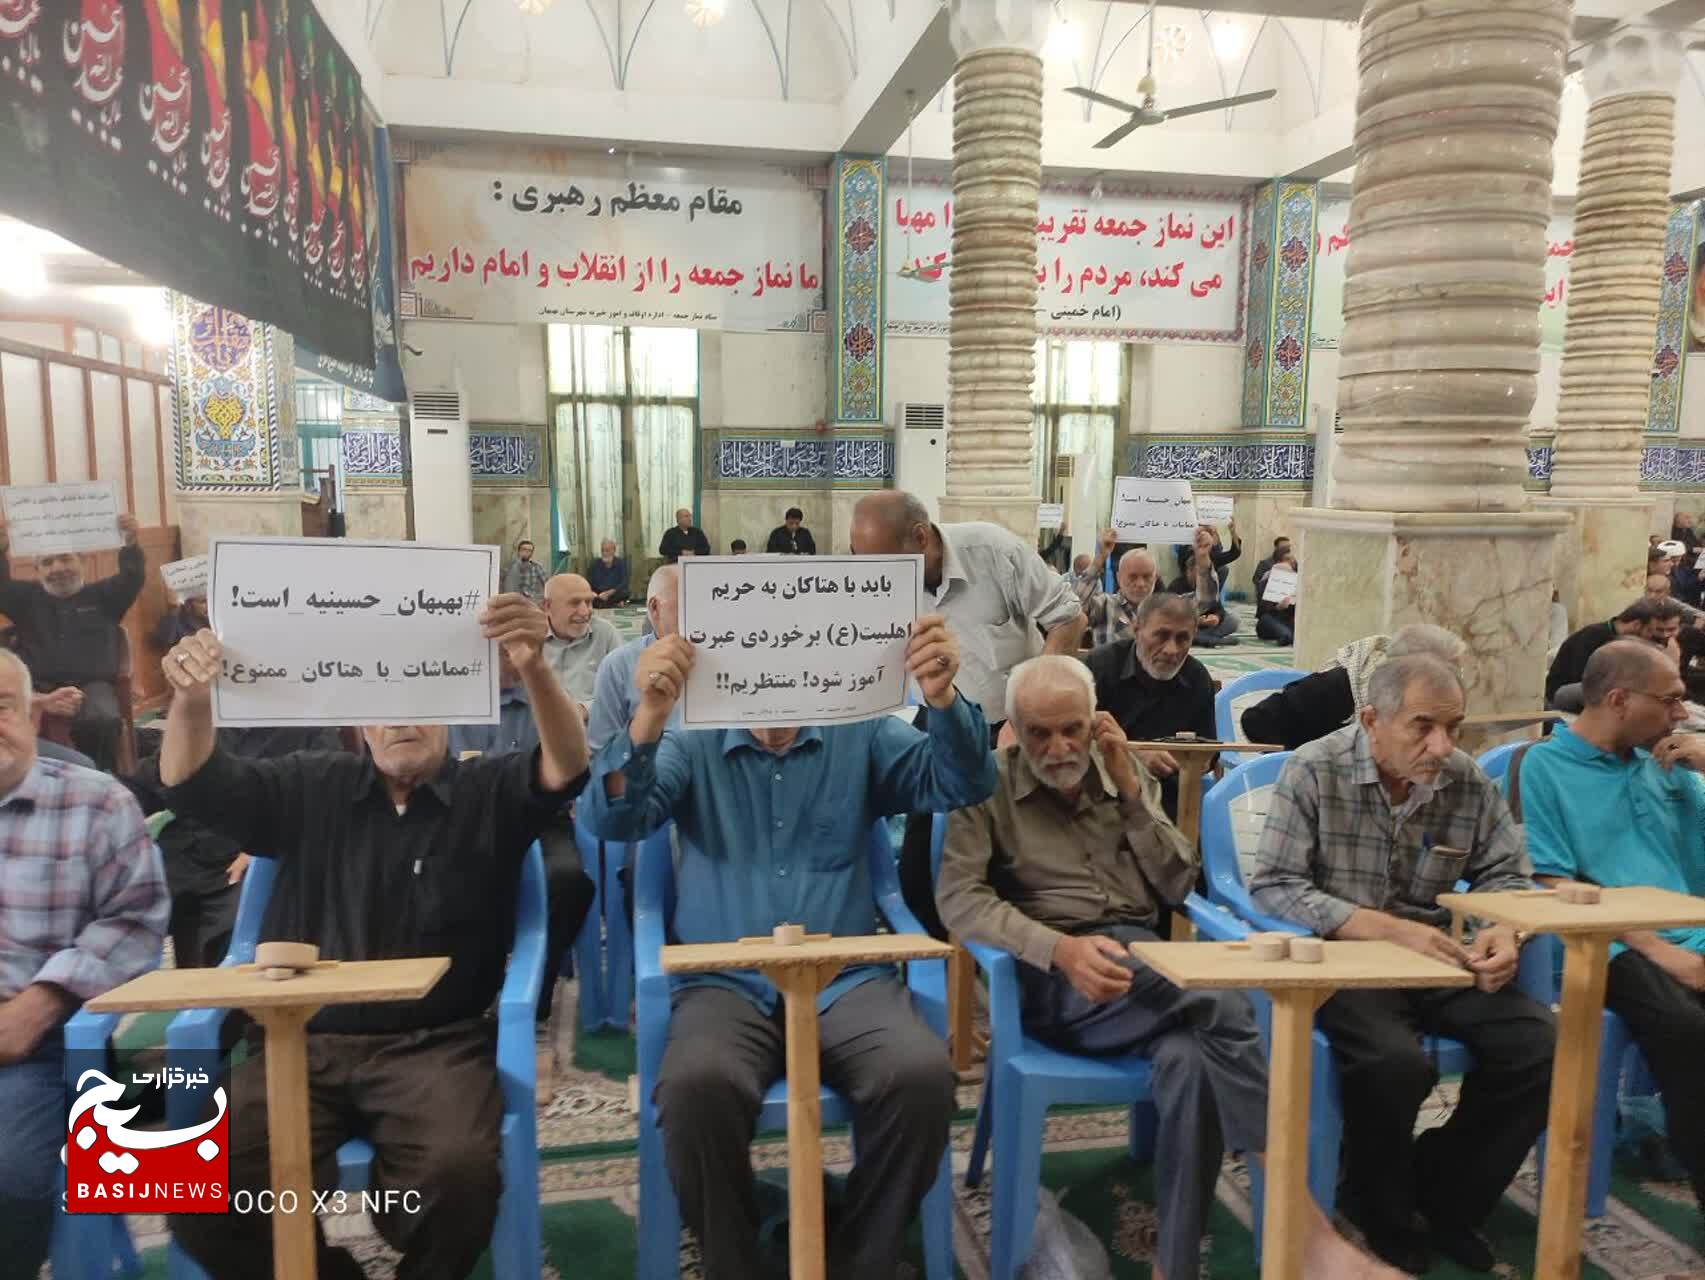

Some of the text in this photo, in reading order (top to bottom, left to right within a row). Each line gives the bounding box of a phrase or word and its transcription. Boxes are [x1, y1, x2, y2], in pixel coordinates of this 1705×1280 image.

[512, 186, 601, 216] رهبری
[610, 181, 680, 217] معظم
[689, 187, 742, 221] مقام
[1034, 206, 1089, 245] تقریب
[1092, 214, 1148, 245] جمعه
[1152, 211, 1197, 250] نماز
[1200, 213, 1237, 250] این
[410, 246, 475, 284] داریم
[480, 246, 529, 288] امام
[538, 260, 552, 289] و
[554, 250, 627, 288] انقلاب
[631, 255, 655, 297] از
[657, 256, 682, 296] را
[686, 264, 746, 297] جمعه
[753, 261, 794, 298] نماز
[798, 262, 820, 289] ما
[1057, 255, 1075, 296] را
[1079, 263, 1134, 297] مردم
[1138, 261, 1185, 288] کند،
[1188, 272, 1224, 298] می
[1051, 304, 1121, 321] (امام خمینی
[712, 575, 891, 601] باید با هتاکان به حریم
[689, 629, 735, 649] عبرت
[741, 625, 820, 648] برخوردی
[717, 666, 885, 695] آموز شود! منتظریم!!
